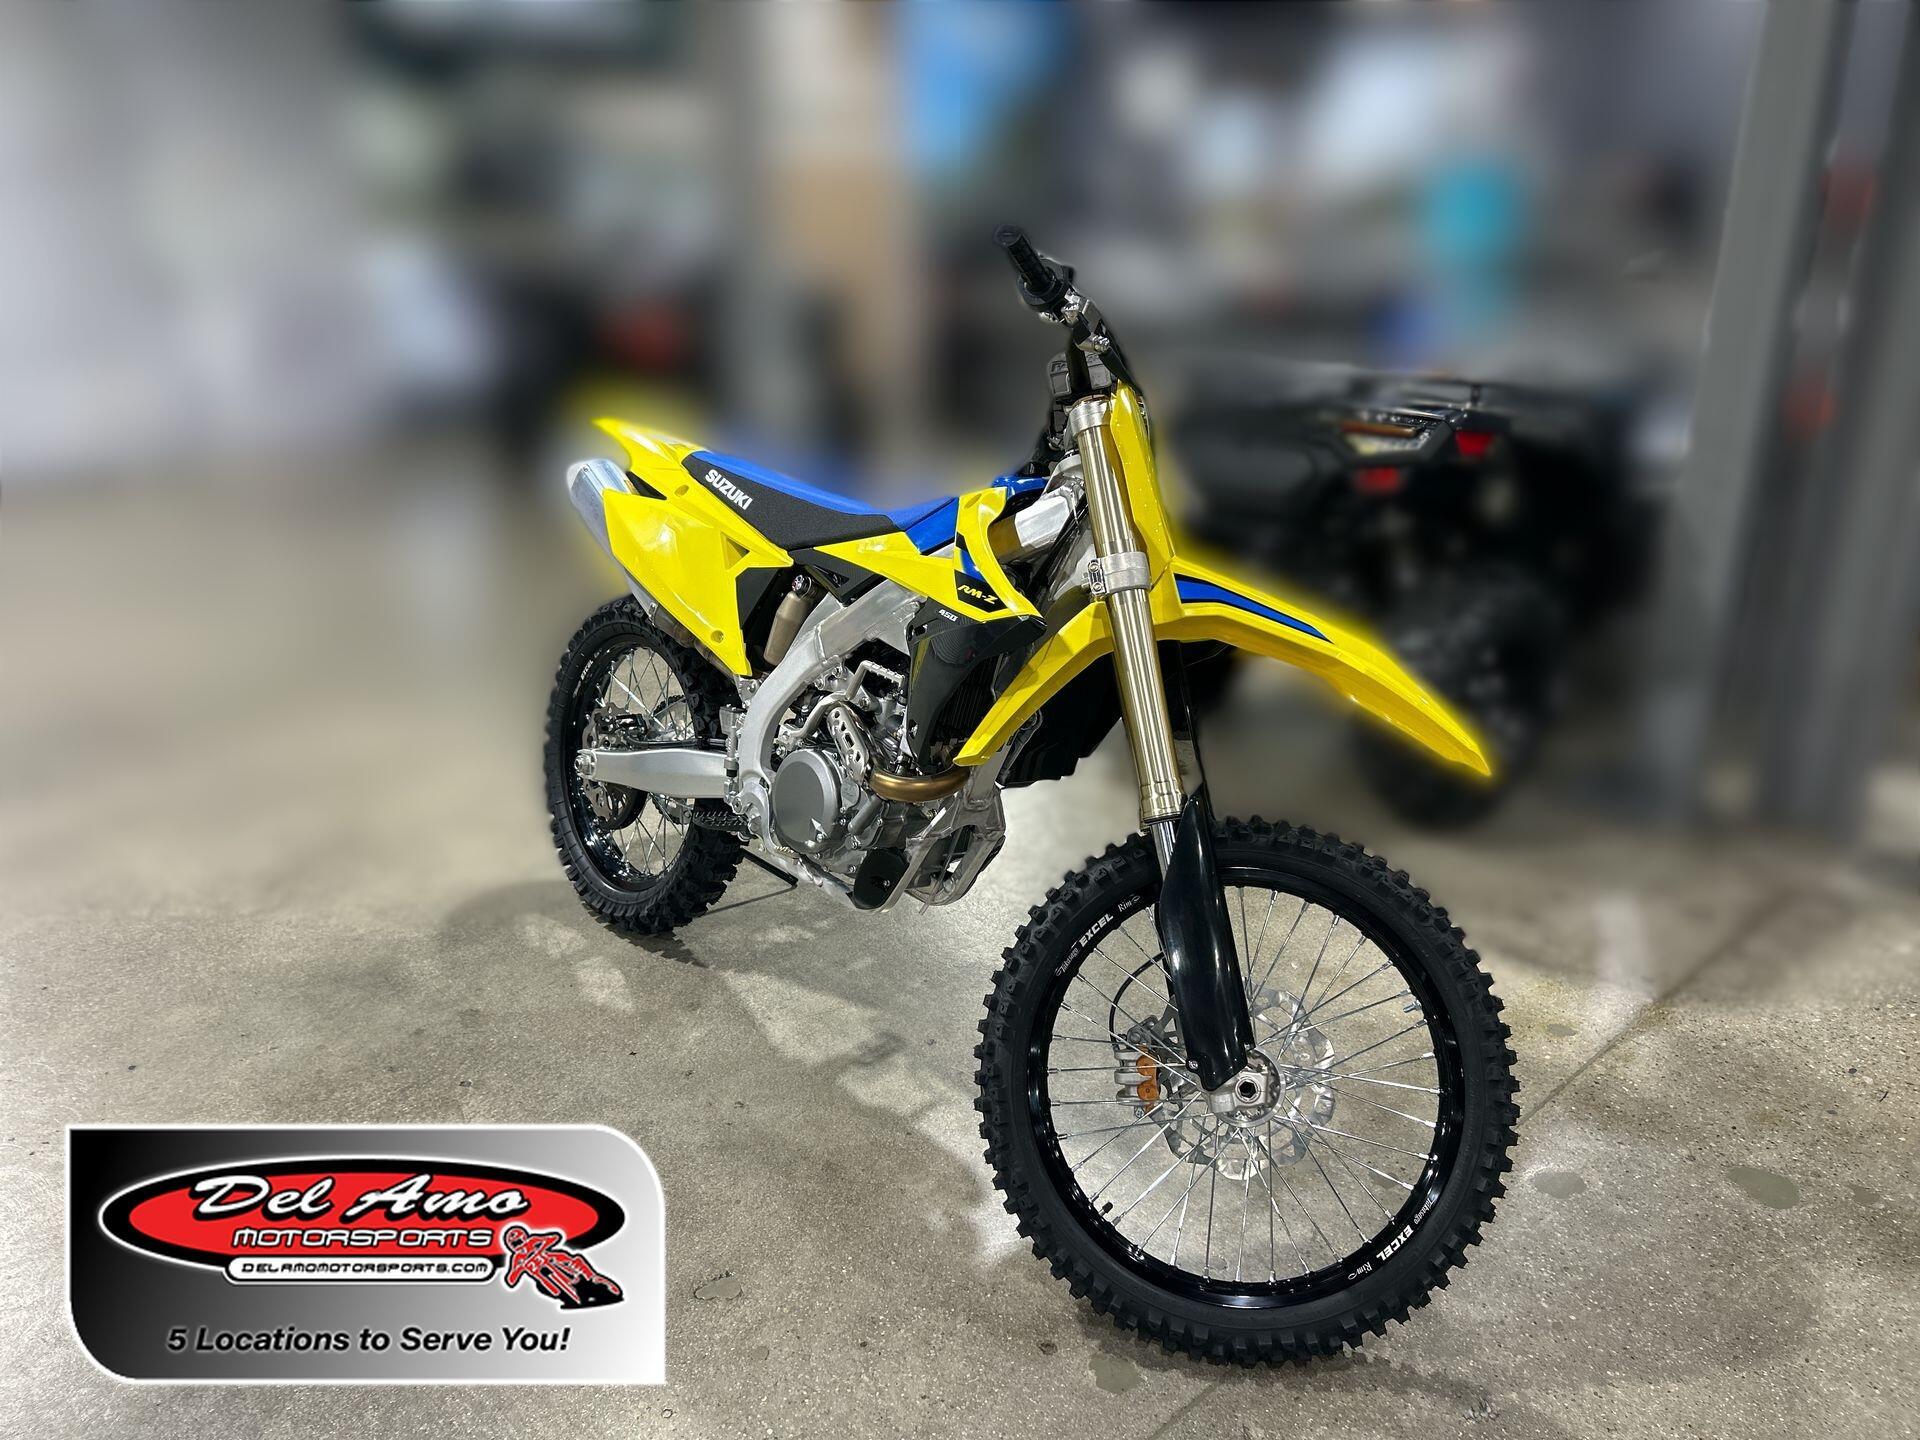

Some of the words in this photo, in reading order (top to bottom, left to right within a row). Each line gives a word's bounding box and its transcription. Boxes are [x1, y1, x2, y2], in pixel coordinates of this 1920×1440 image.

[705, 469, 753, 510] SUZUKI
[957, 584, 999, 605] RM-Z
[939, 608, 959, 622] 450
[1079, 913, 1114, 947] EXCEL
[1376, 1224, 1414, 1261] EXCEL
